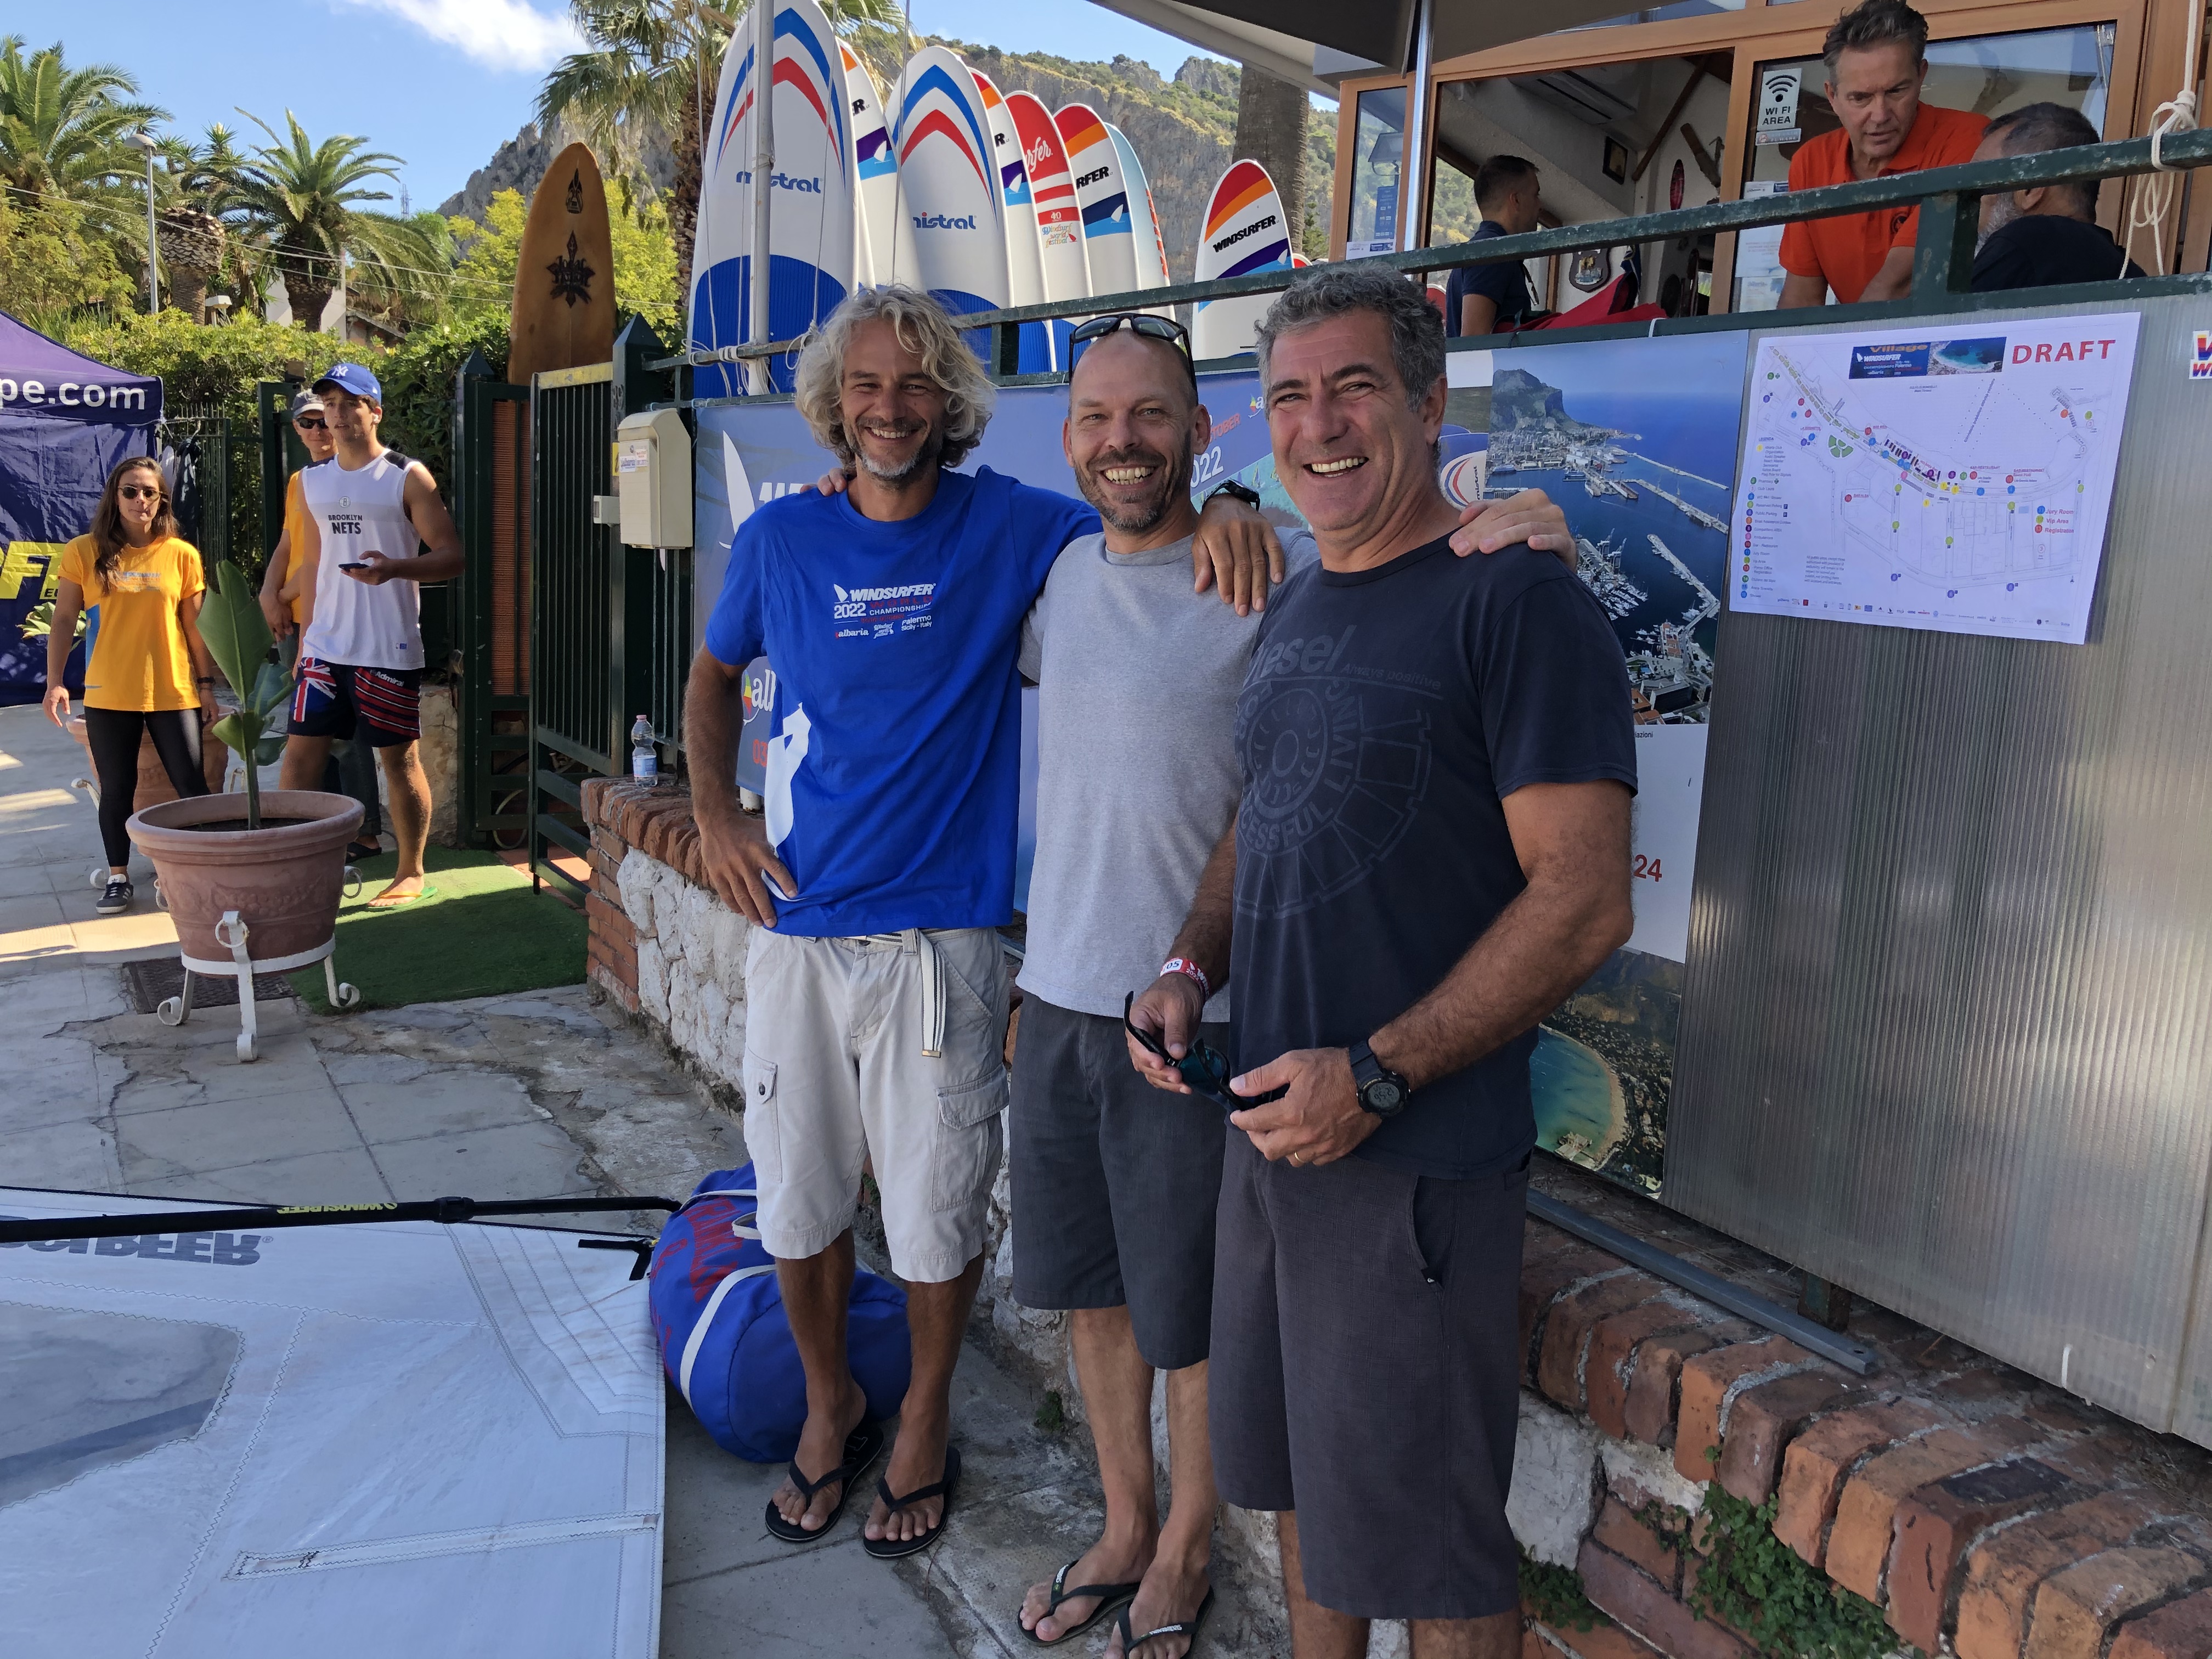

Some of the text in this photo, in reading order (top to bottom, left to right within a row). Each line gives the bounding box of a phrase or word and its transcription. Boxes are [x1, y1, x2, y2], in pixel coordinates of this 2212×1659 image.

[1765, 107, 1778, 116] WI
[1762, 116, 1791, 126] AREA
[736, 171, 821, 194] mstral
[1213, 215, 1276, 253] WINDSURFER
[1870, 345, 1928, 353] Village
[2012, 340, 2116, 365] DRAFT
[1864, 354, 1901, 362] WINDSURFER
[332, 522, 362, 534] NETS
[850, 583, 934, 602] WINDSURFER
[870, 596, 933, 608] WORLD
[834, 602, 867, 619] 2022
[901, 615, 931, 625] Palermo
[838, 628, 869, 637] albaria
[376, 670, 405, 687] Admiral
[1341, 663, 1442, 691] Always positive
